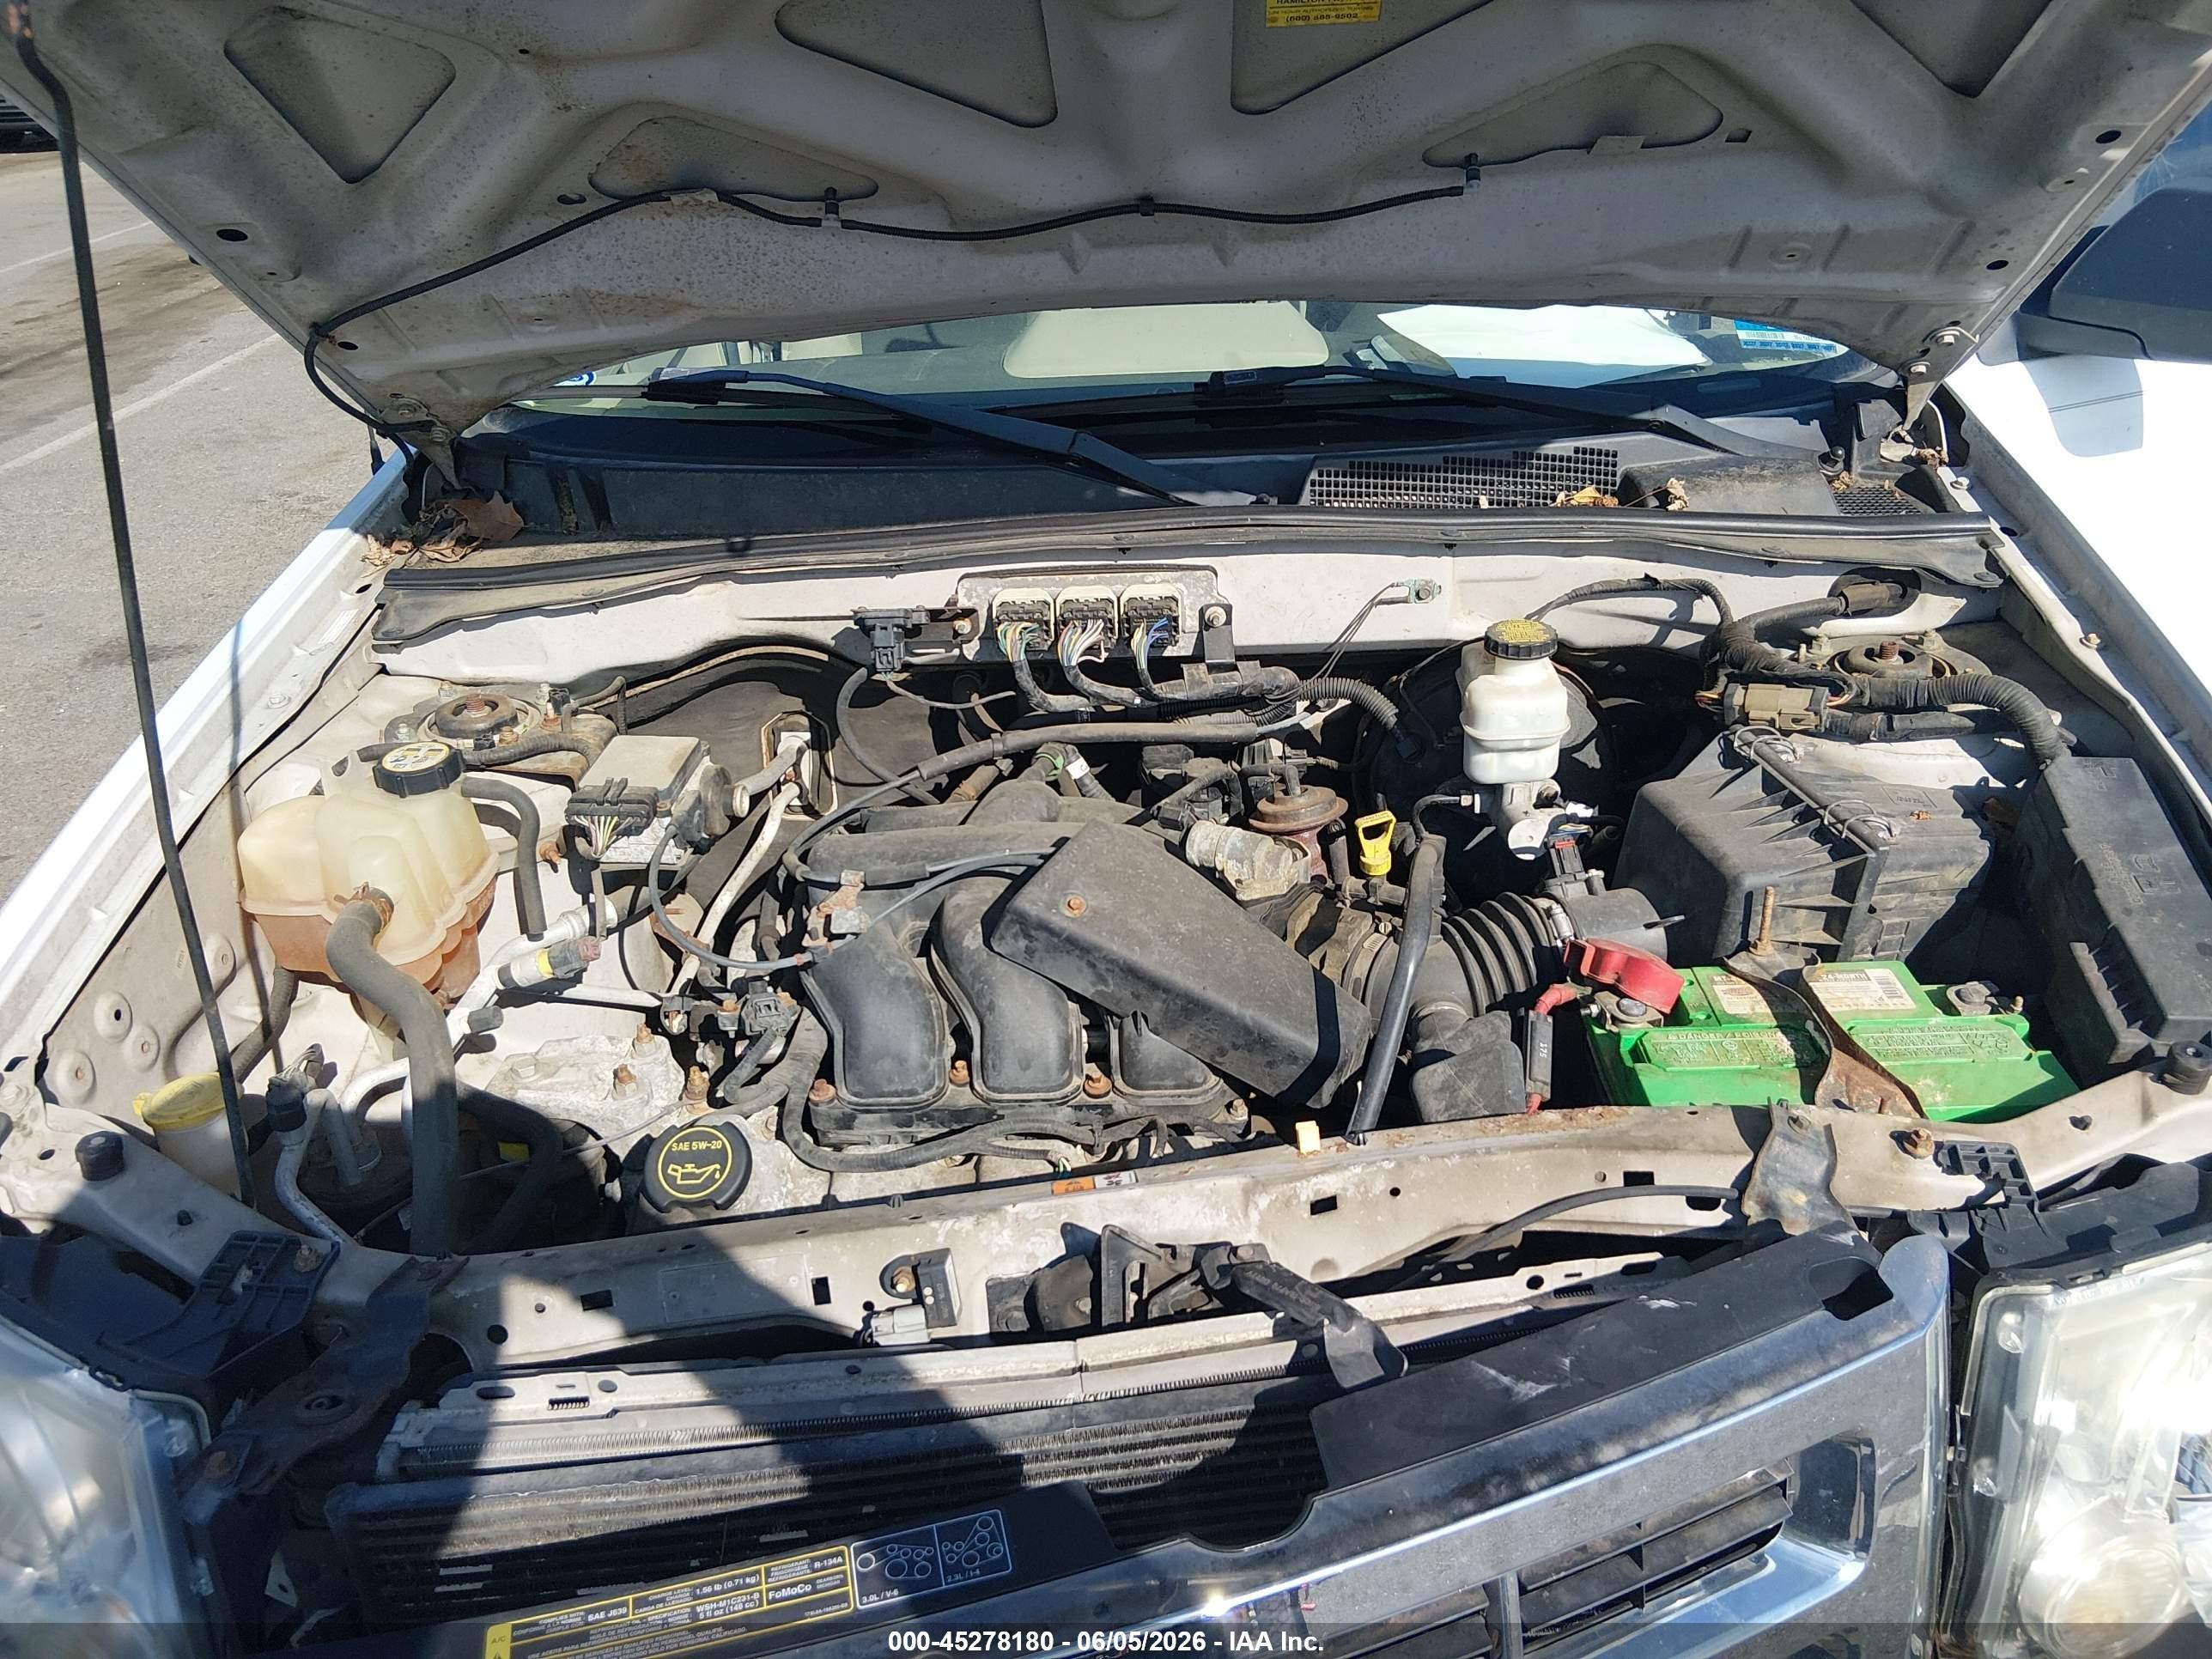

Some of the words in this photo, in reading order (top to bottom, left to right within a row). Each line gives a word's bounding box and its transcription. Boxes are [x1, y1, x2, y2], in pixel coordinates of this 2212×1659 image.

[672, 1141, 690, 1152] SAE
[691, 1139, 723, 1151] 5W-20
[813, 1555, 843, 1570] R-134A
[695, 1585, 713, 1595] 1.56
[714, 1583, 723, 1591] lb
[724, 1577, 744, 1589] (0.71
[745, 1573, 760, 1584] kg)
[946, 1573, 963, 1583] 2.3L
[768, 1583, 812, 1600] FoMoCo
[861, 1594, 880, 1604] 3.0L
[885, 1588, 899, 1598] V-6
[696, 1591, 761, 1613] WSH-M1C231-B
[714, 1607, 725, 1616] oz
[744, 1600, 760, 1611] cc)
[587, 1610, 605, 1622] SAE
[607, 1607, 628, 1618] J639
